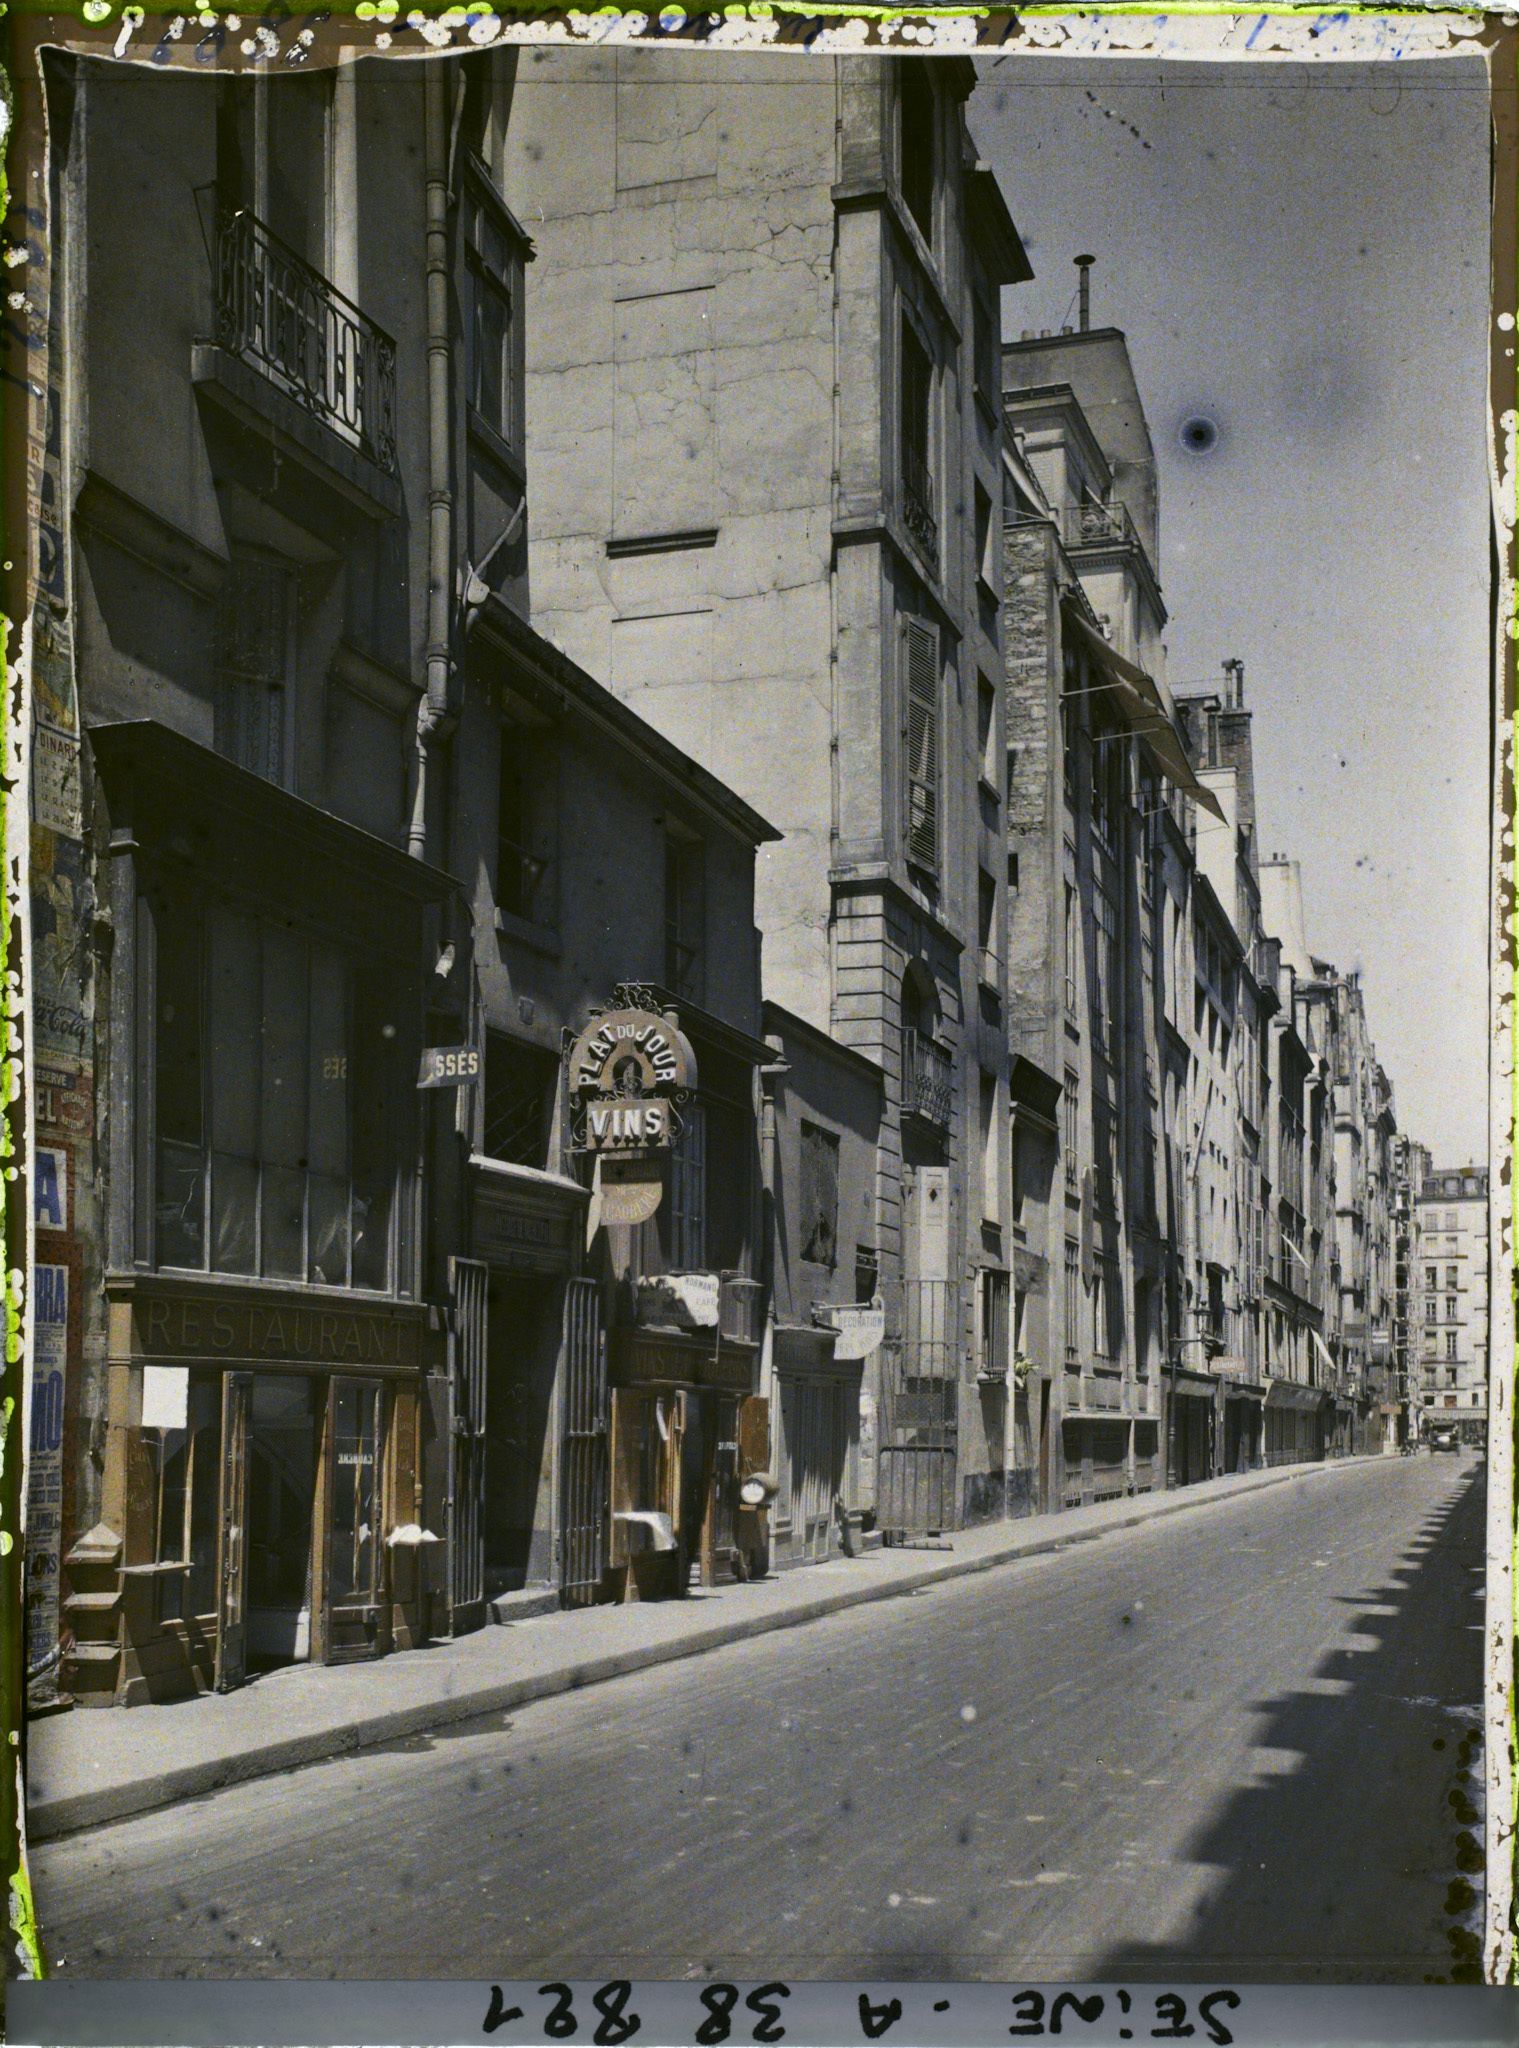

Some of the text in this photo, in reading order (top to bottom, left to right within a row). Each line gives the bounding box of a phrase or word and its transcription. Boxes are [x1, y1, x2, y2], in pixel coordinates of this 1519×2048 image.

[40, 733, 76, 761] DINARD
[578, 1023, 677, 1085] PLAT DU JOUR
[591, 1107, 662, 1135] VINS
[147, 1299, 408, 1359] RESTAURANT
[482, 1980, 639, 2047] 821
[699, 1986, 791, 2045] 38
[858, 1992, 902, 2041] A
